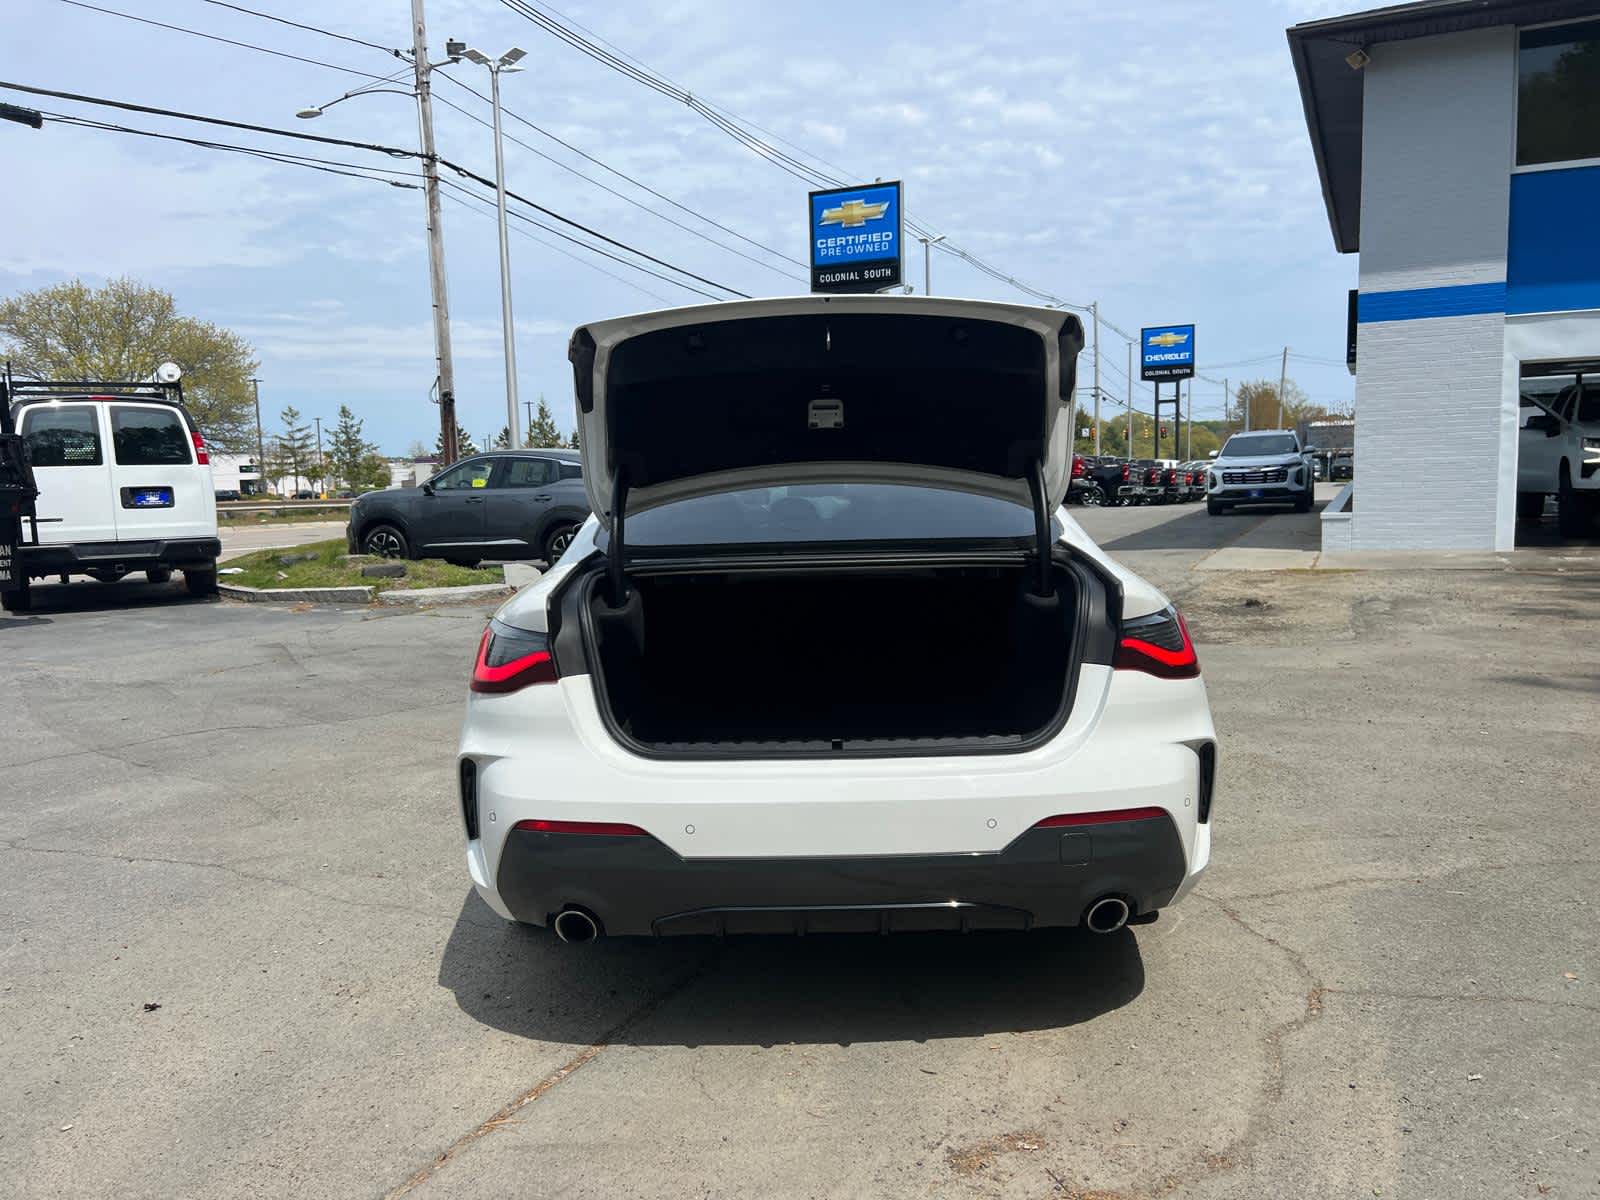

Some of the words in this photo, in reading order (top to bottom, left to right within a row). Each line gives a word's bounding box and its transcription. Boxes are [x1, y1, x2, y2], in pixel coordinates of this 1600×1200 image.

[817, 231, 892, 248] CERTIFIED
[820, 242, 889, 256] PRE-OWNED
[820, 272, 860, 283] COLONIAL
[864, 268, 891, 279] SOUTH
[1145, 352, 1190, 362] CHEVROLET
[1144, 369, 1170, 377] COLONIAL
